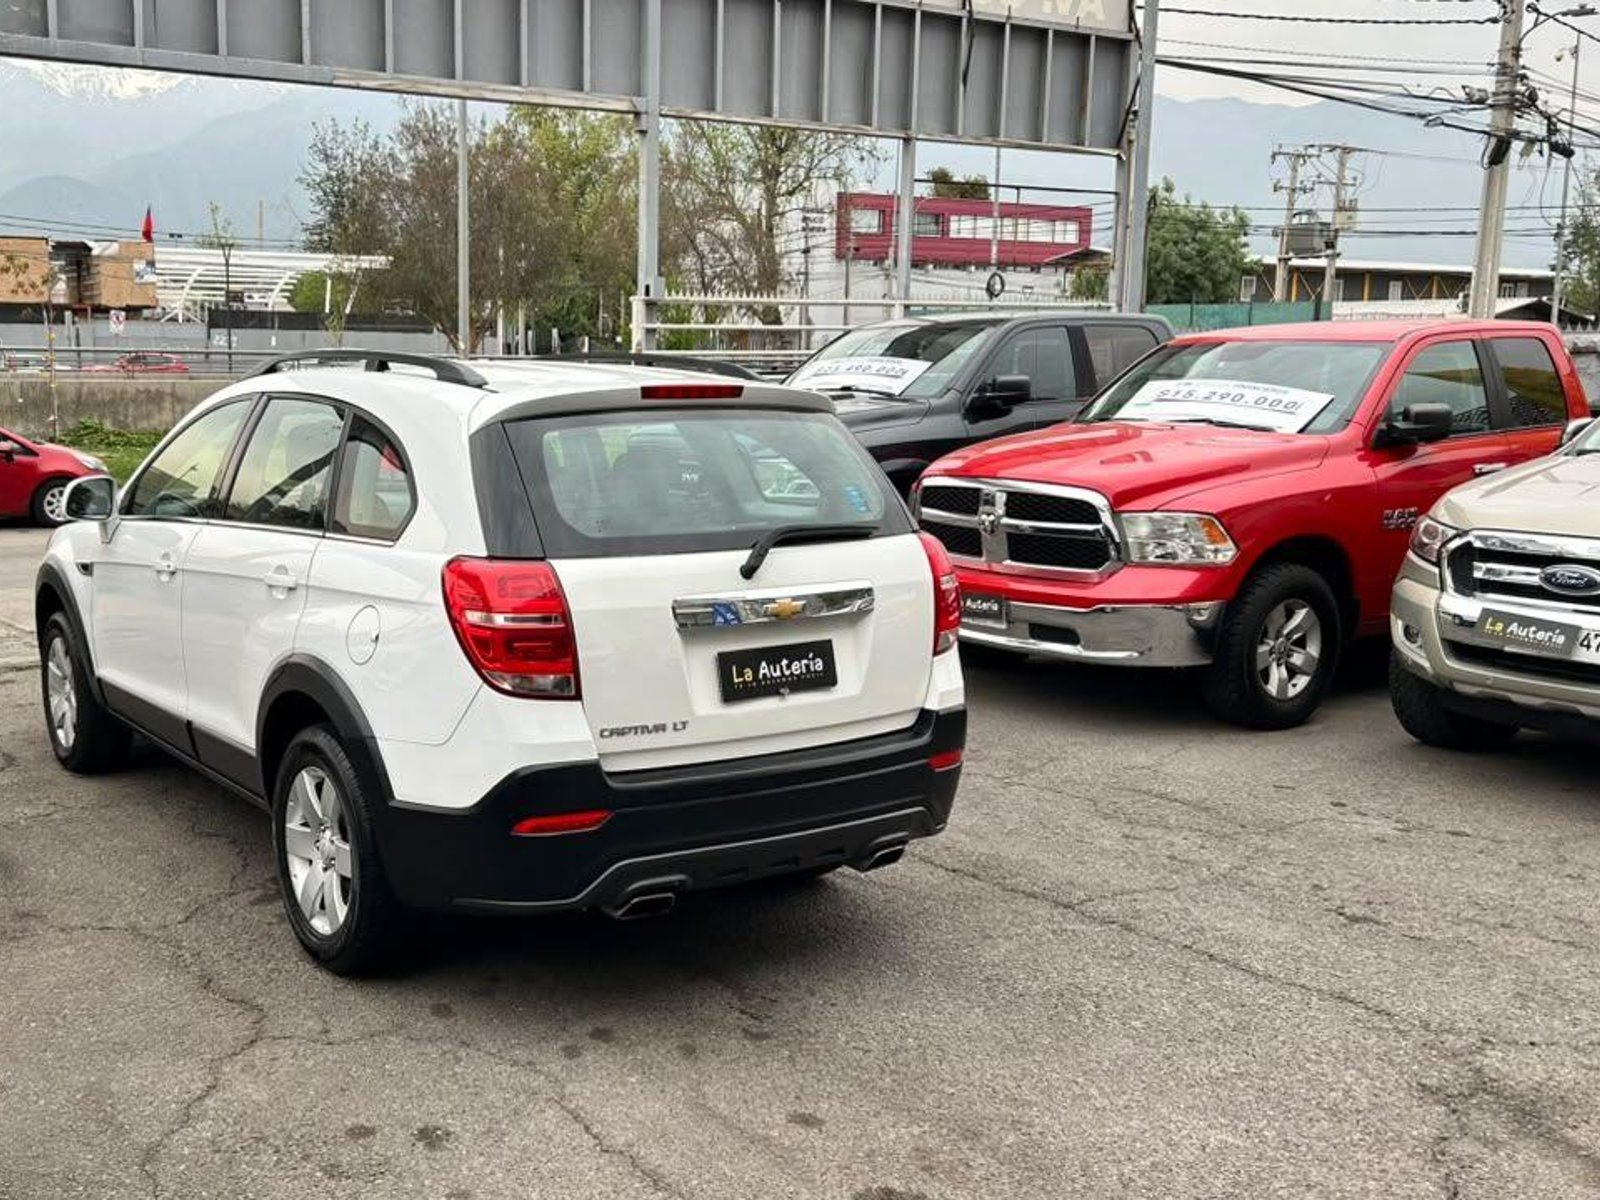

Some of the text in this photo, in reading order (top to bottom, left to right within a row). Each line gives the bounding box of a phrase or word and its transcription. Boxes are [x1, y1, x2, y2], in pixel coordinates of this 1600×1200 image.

[1484, 617, 1504, 632] La
[1506, 622, 1565, 644] Autería
[732, 664, 753, 683] La
[758, 652, 824, 680] Autería
[599, 719, 689, 739] CAPTIVA LT
